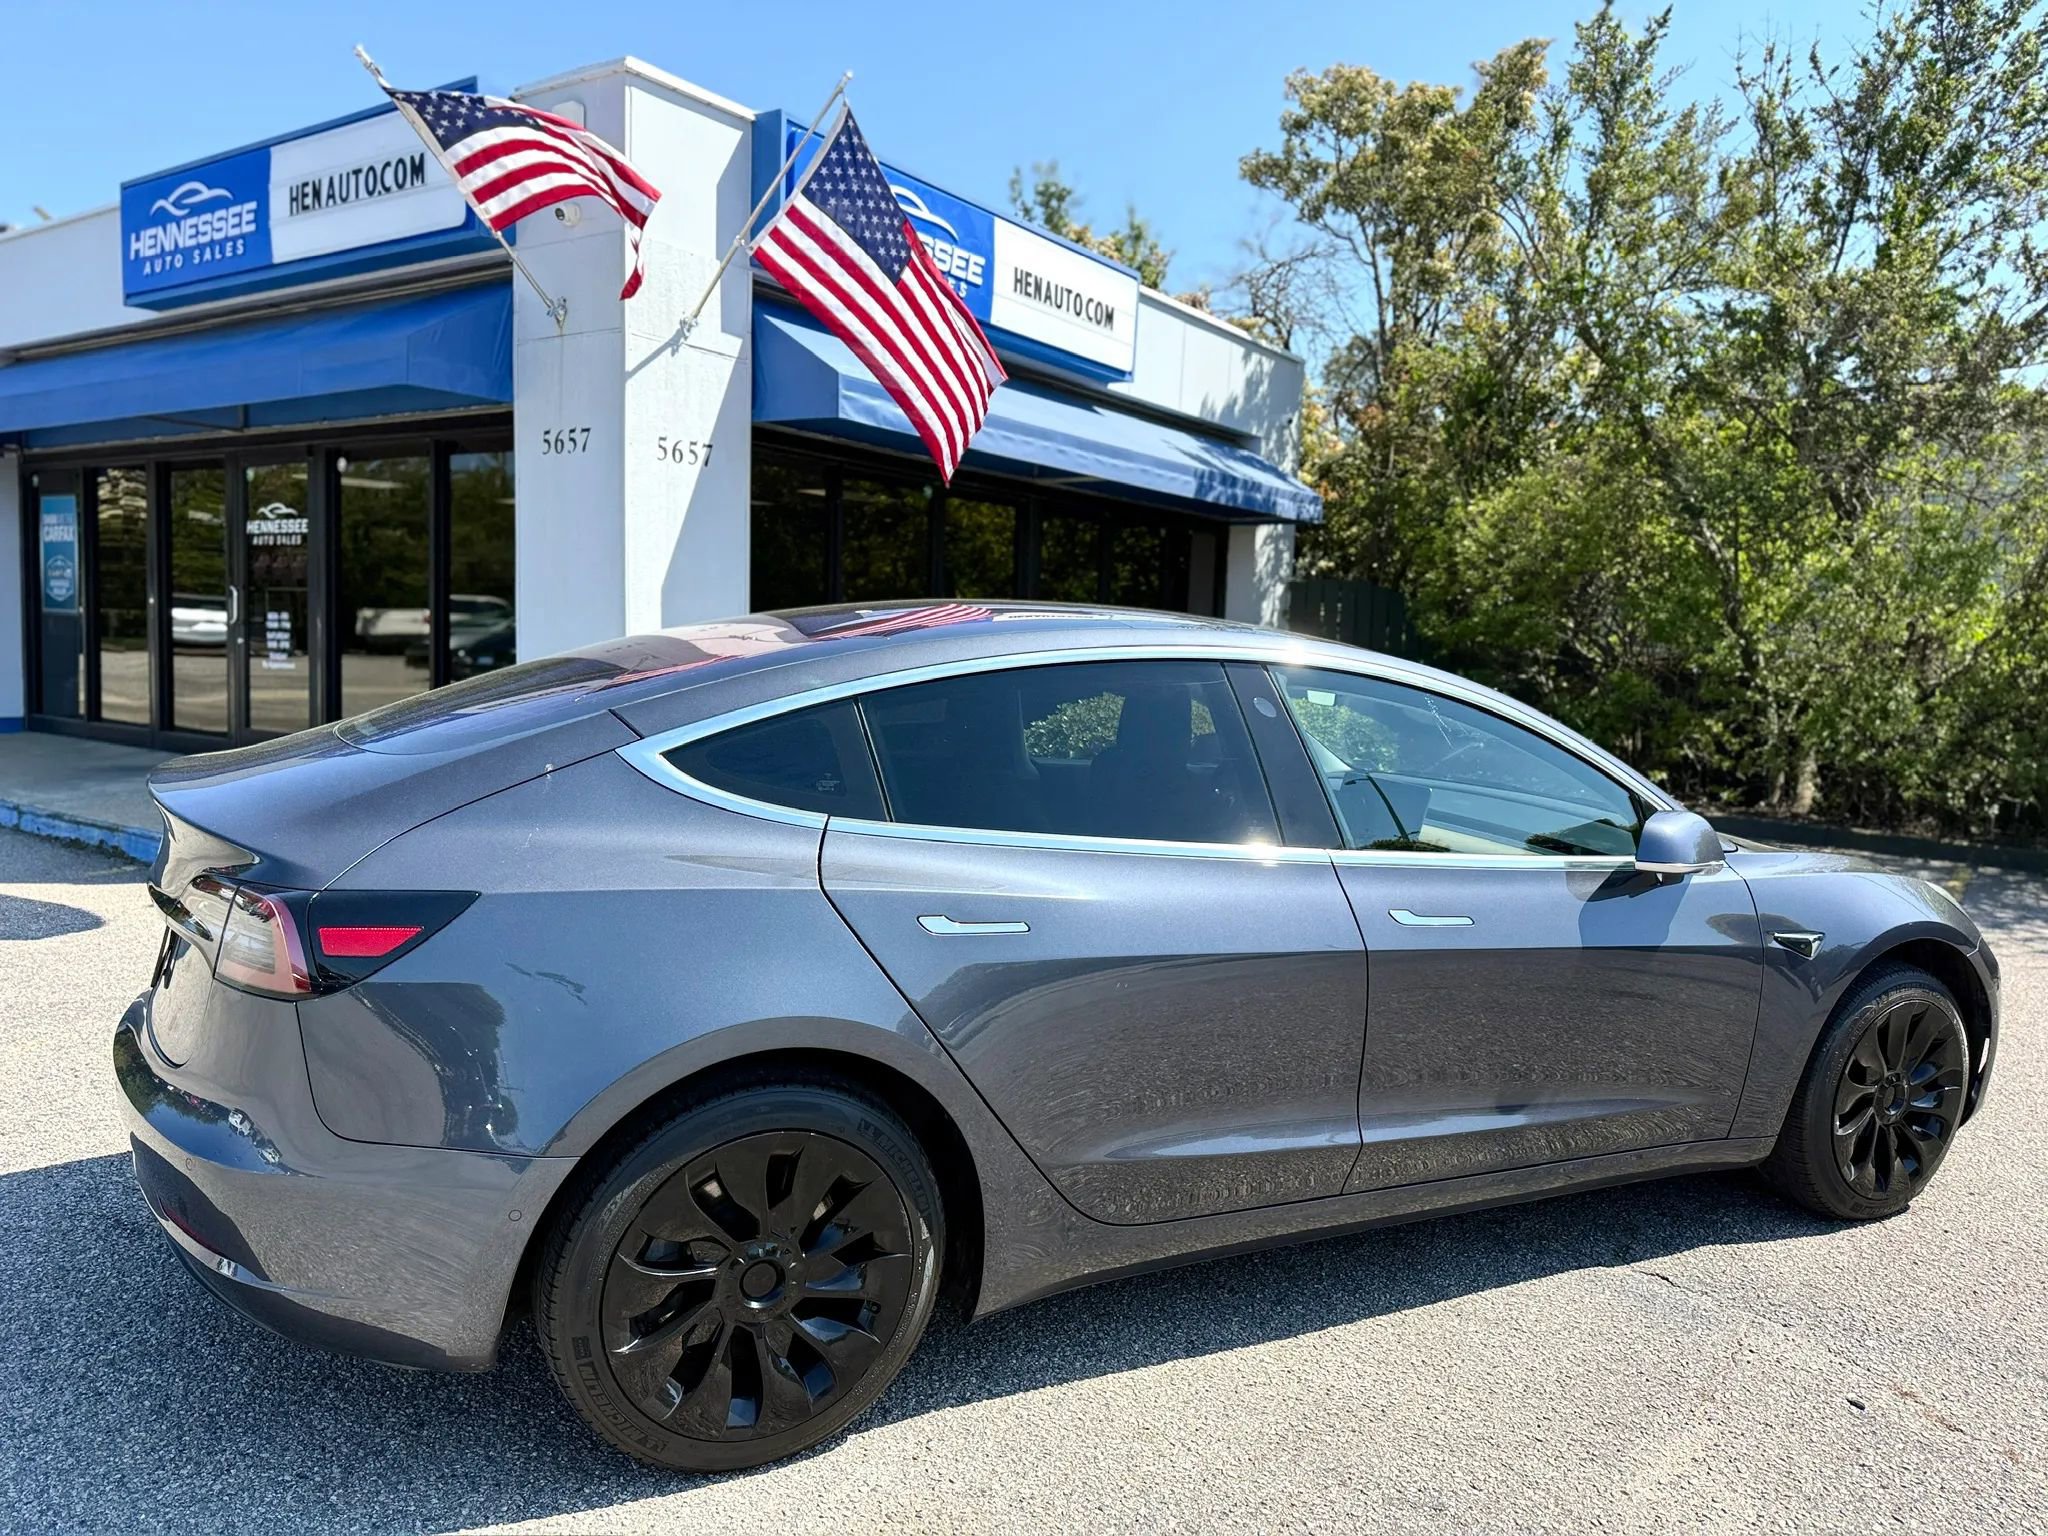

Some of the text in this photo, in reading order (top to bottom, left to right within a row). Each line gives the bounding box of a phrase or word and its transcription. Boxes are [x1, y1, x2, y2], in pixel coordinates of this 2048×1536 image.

[129, 200, 258, 261] HENNESSEE
[143, 238, 244, 275] AUTO SALES
[1013, 266, 1115, 331] HENAUTO.COM
[542, 427, 591, 455] 5657
[657, 436, 713, 467] 5657
[246, 518, 309, 534] HENNESSEE
[252, 534, 302, 546] AUTO SALES
